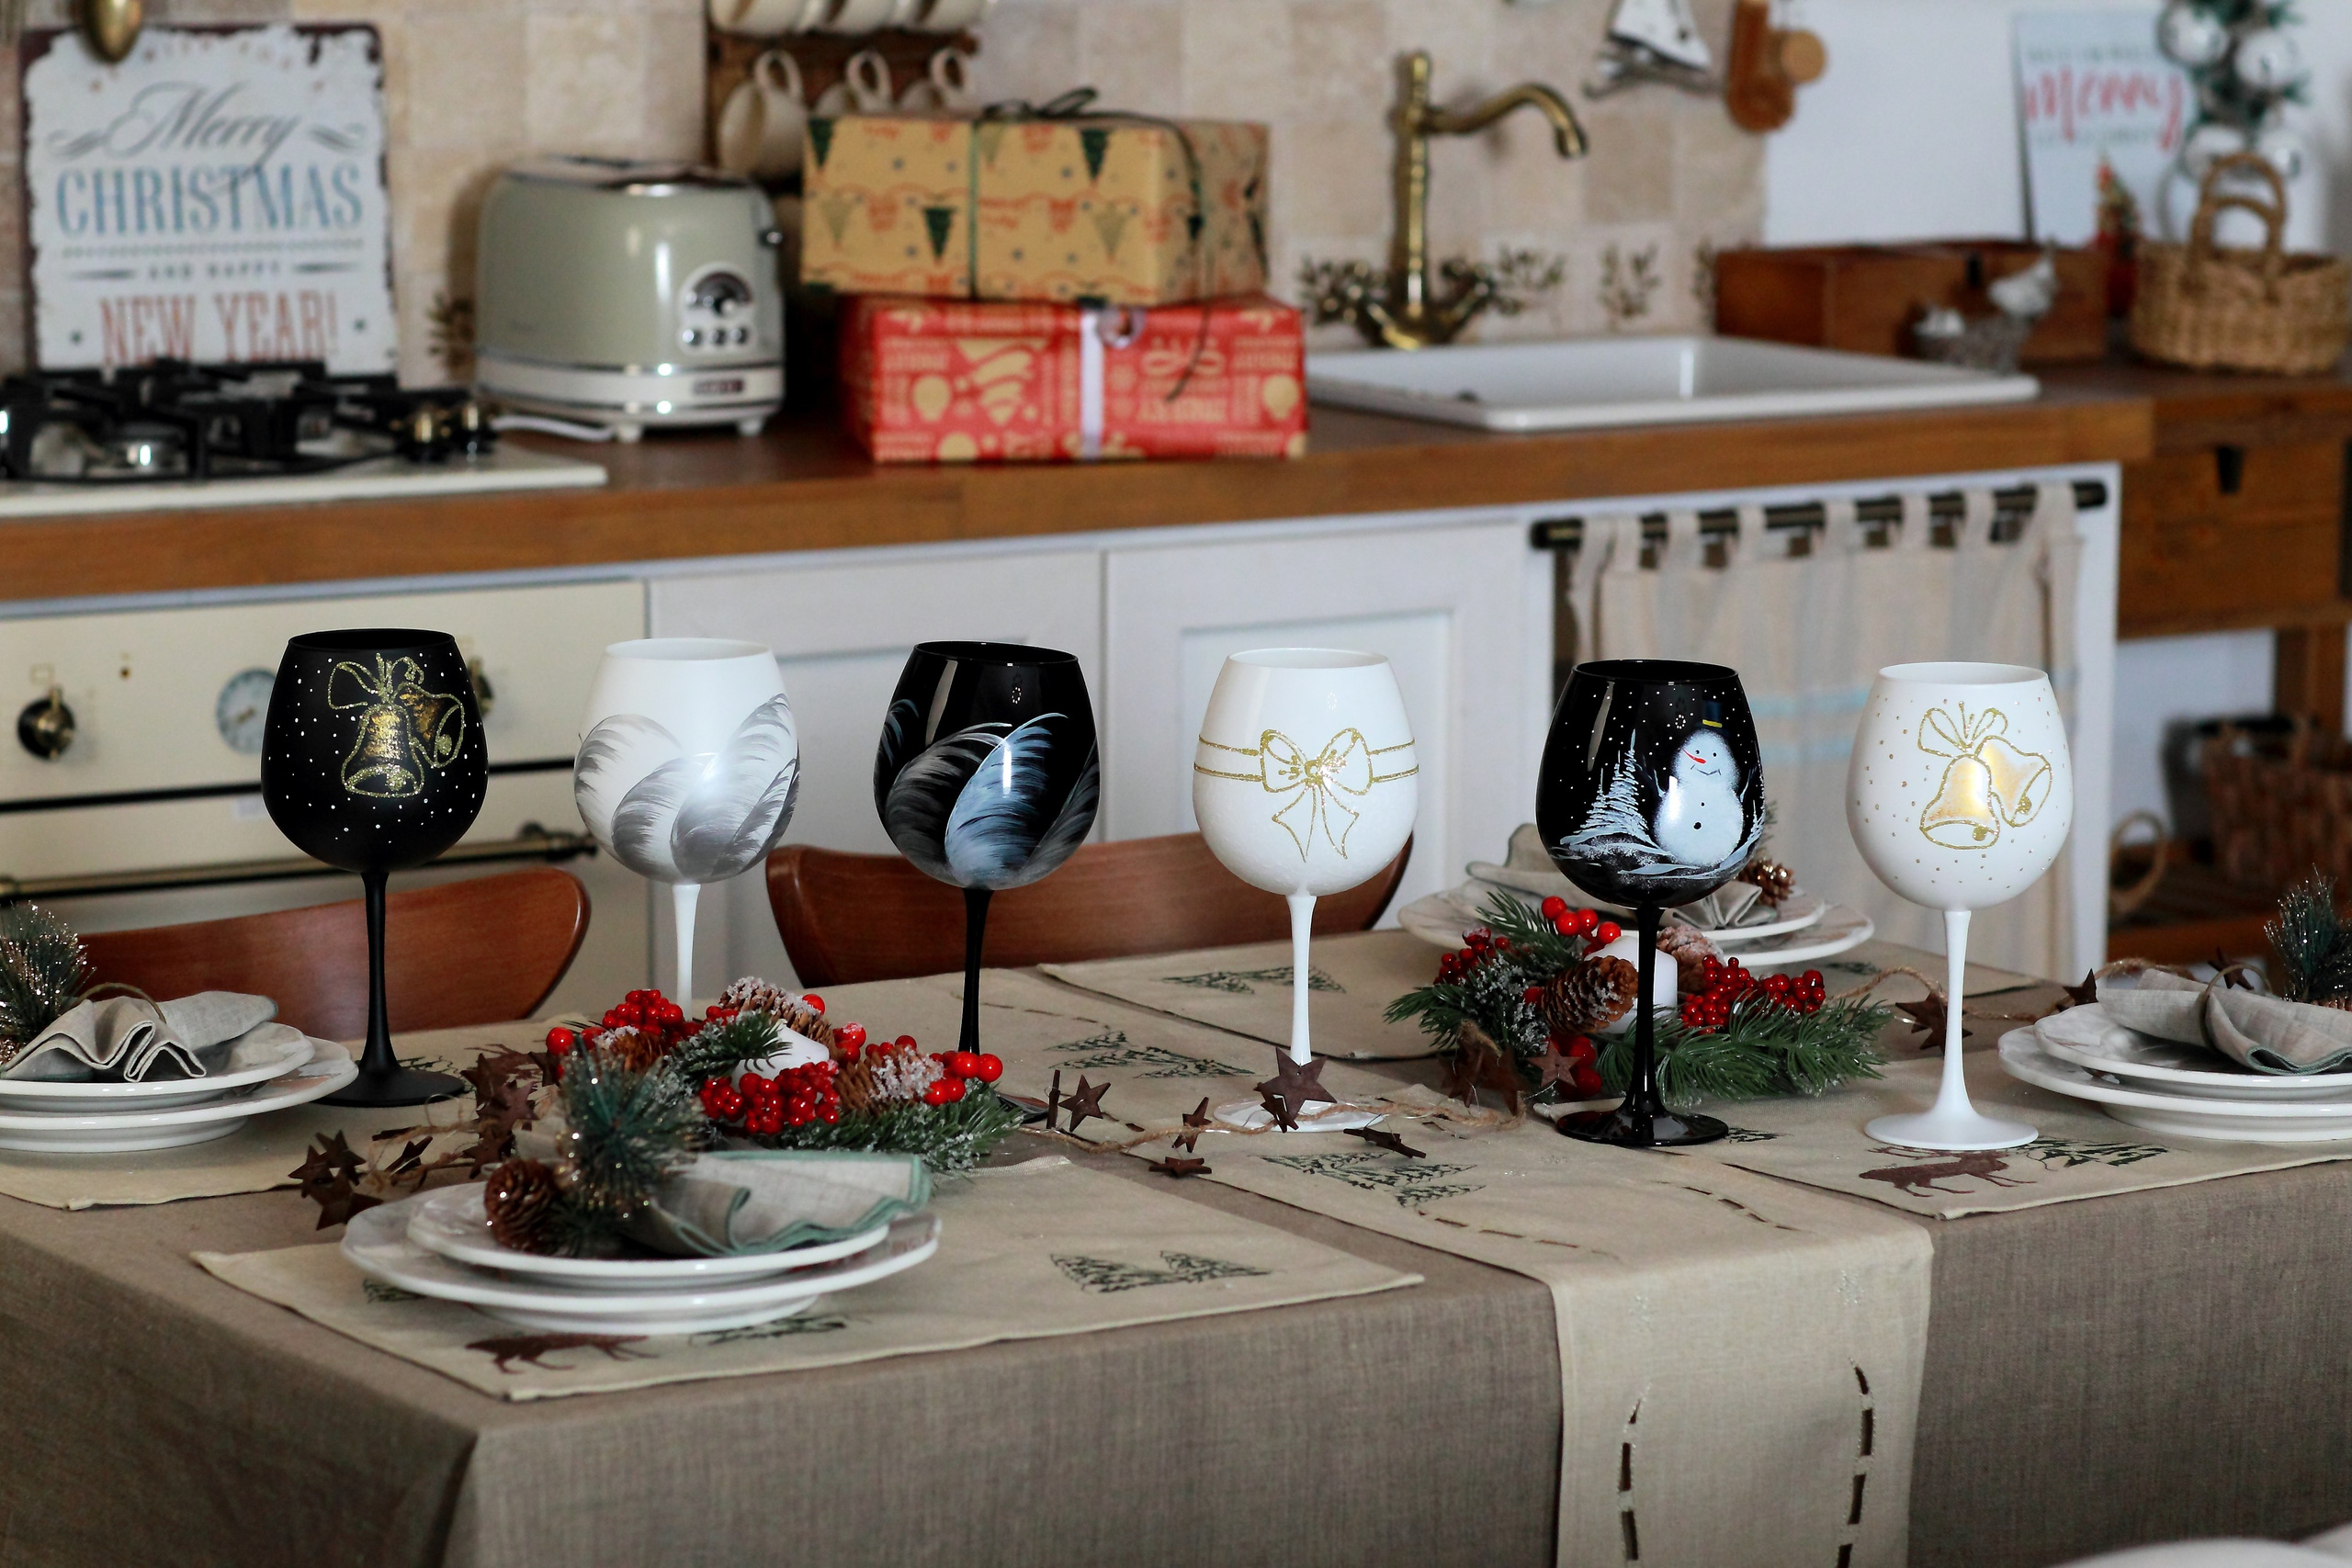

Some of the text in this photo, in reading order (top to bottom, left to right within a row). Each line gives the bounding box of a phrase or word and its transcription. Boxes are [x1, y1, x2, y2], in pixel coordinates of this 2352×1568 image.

[99, 80, 302, 192] Merry
[55, 161, 365, 238] CHRISTMAS
[98, 288, 338, 365] NEW YEAR!
